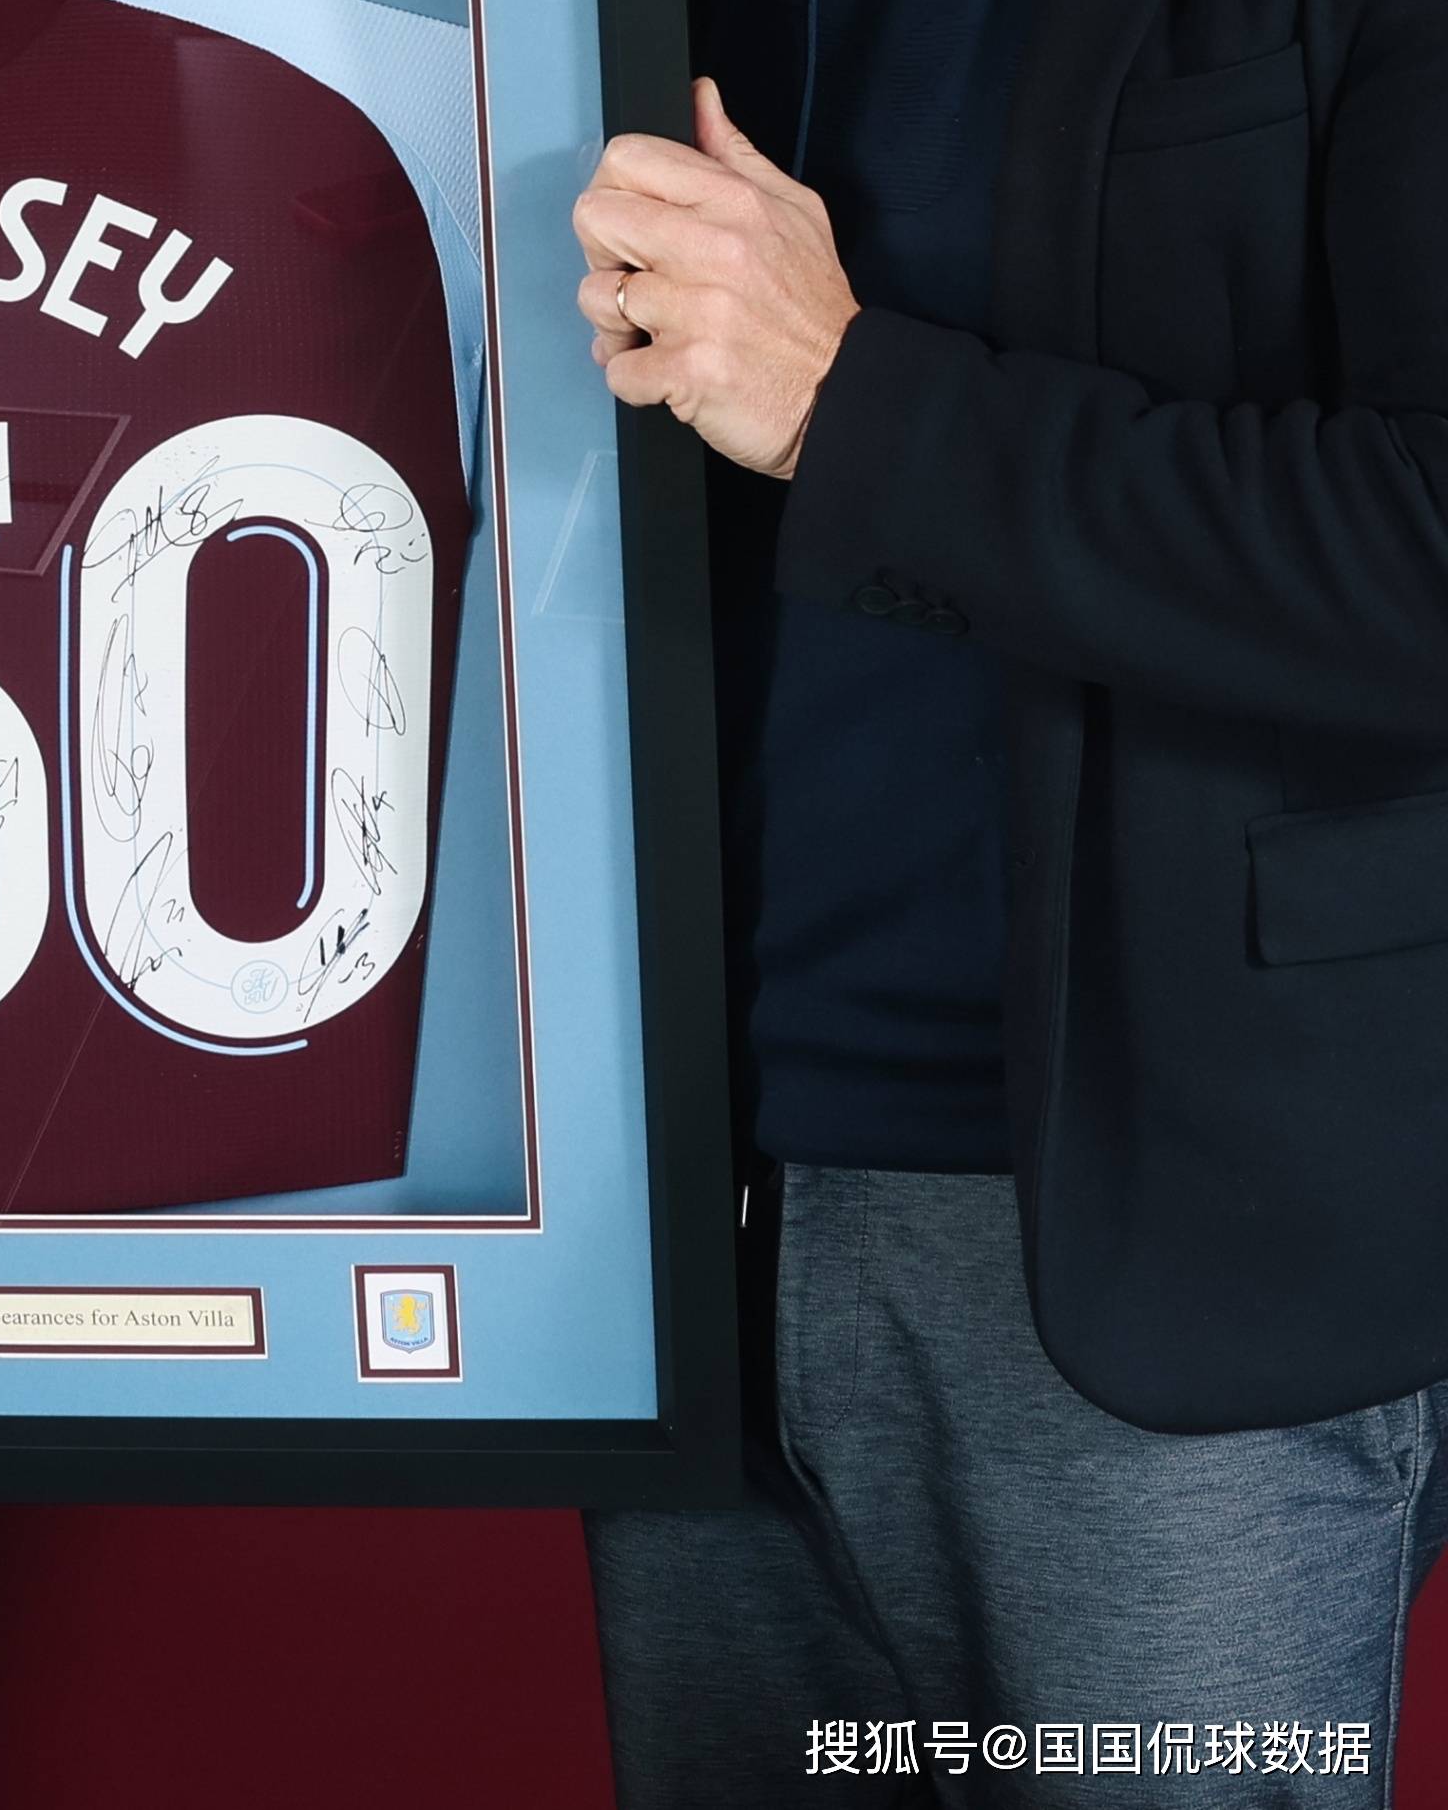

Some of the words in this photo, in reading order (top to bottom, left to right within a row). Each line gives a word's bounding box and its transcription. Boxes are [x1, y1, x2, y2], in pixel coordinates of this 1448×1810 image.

[91, 1309, 119, 1326] for
[124, 1310, 182, 1327] Aston
[188, 1310, 235, 1327] Villa
